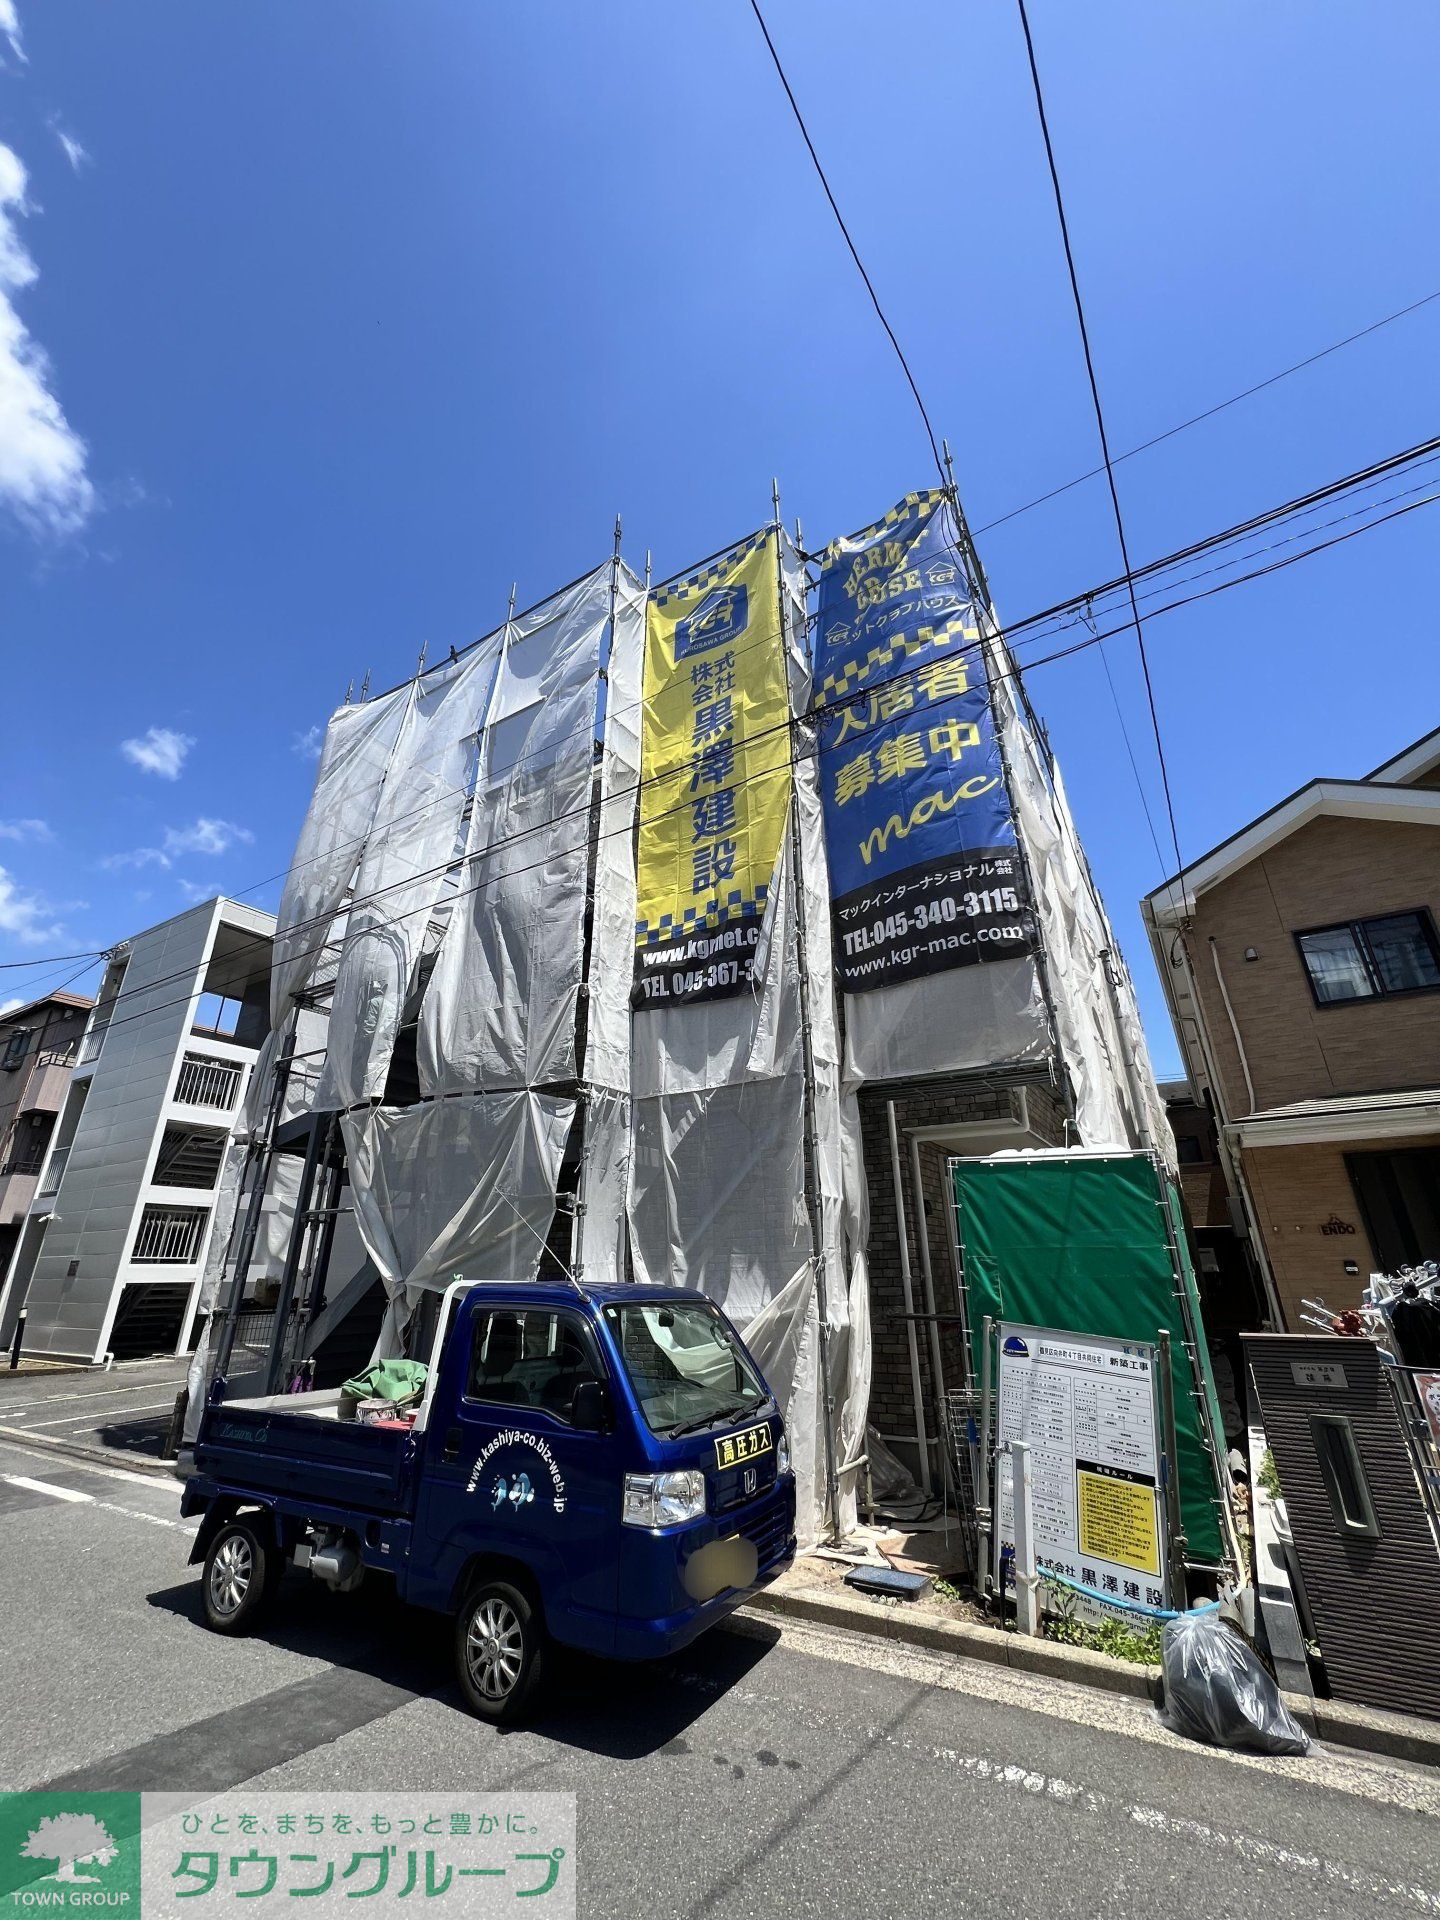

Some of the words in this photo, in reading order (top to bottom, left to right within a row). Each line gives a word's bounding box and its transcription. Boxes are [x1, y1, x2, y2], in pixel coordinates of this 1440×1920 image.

[833, 657, 970, 747] 入居者
[834, 717, 982, 807] 募集中
[689, 694, 738, 896] 黒澤建設
[858, 775, 1000, 865] mac
[845, 924, 1024, 978] www.kgr-mac.com
[1321, 1224, 1356, 1236] ENDO
[1109, 1356, 1149, 1371] 新築工事
[721, 1428, 769, 1464] 高圧ガス
[1080, 1567, 1163, 1608] 黒澤建設
